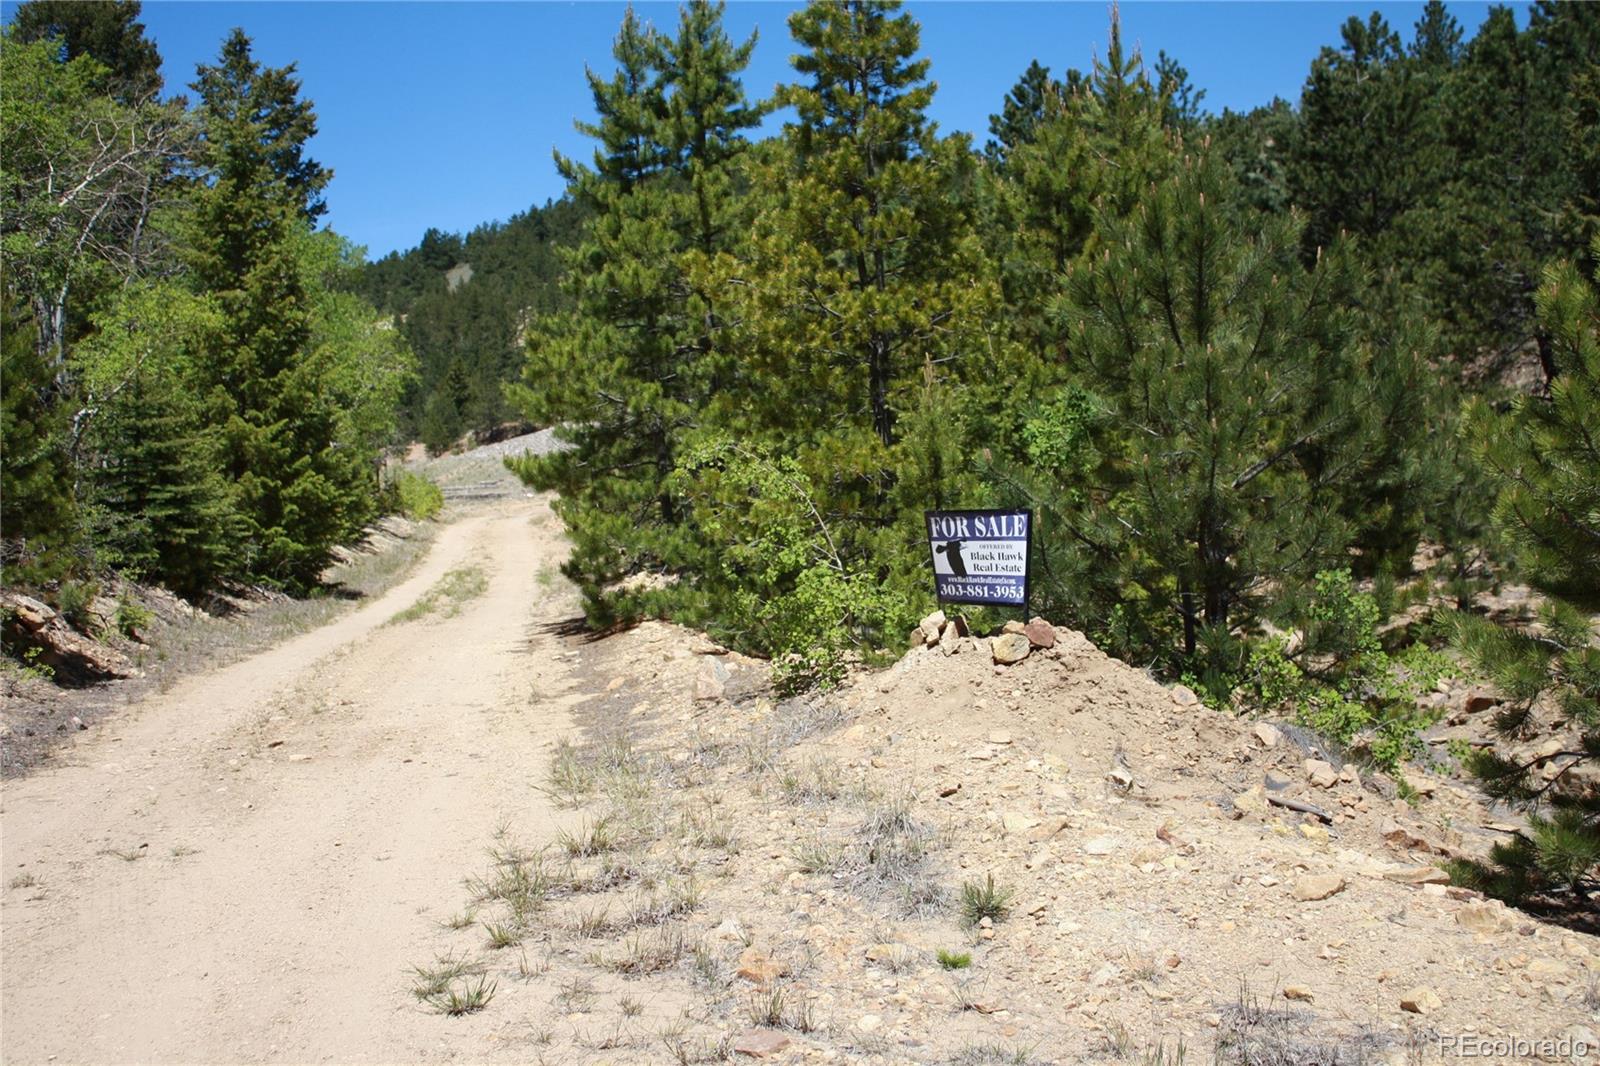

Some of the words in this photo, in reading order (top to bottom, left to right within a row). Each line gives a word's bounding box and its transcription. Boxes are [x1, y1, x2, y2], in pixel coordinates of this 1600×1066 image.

[929, 515, 971, 538] FOR
[975, 514, 1028, 538] SALE
[970, 552, 995, 561] Black
[998, 552, 1023, 561] Hawk
[973, 563, 993, 572] Real
[995, 563, 1022, 573] Estate
[940, 584, 1024, 598] 303-881-3953
